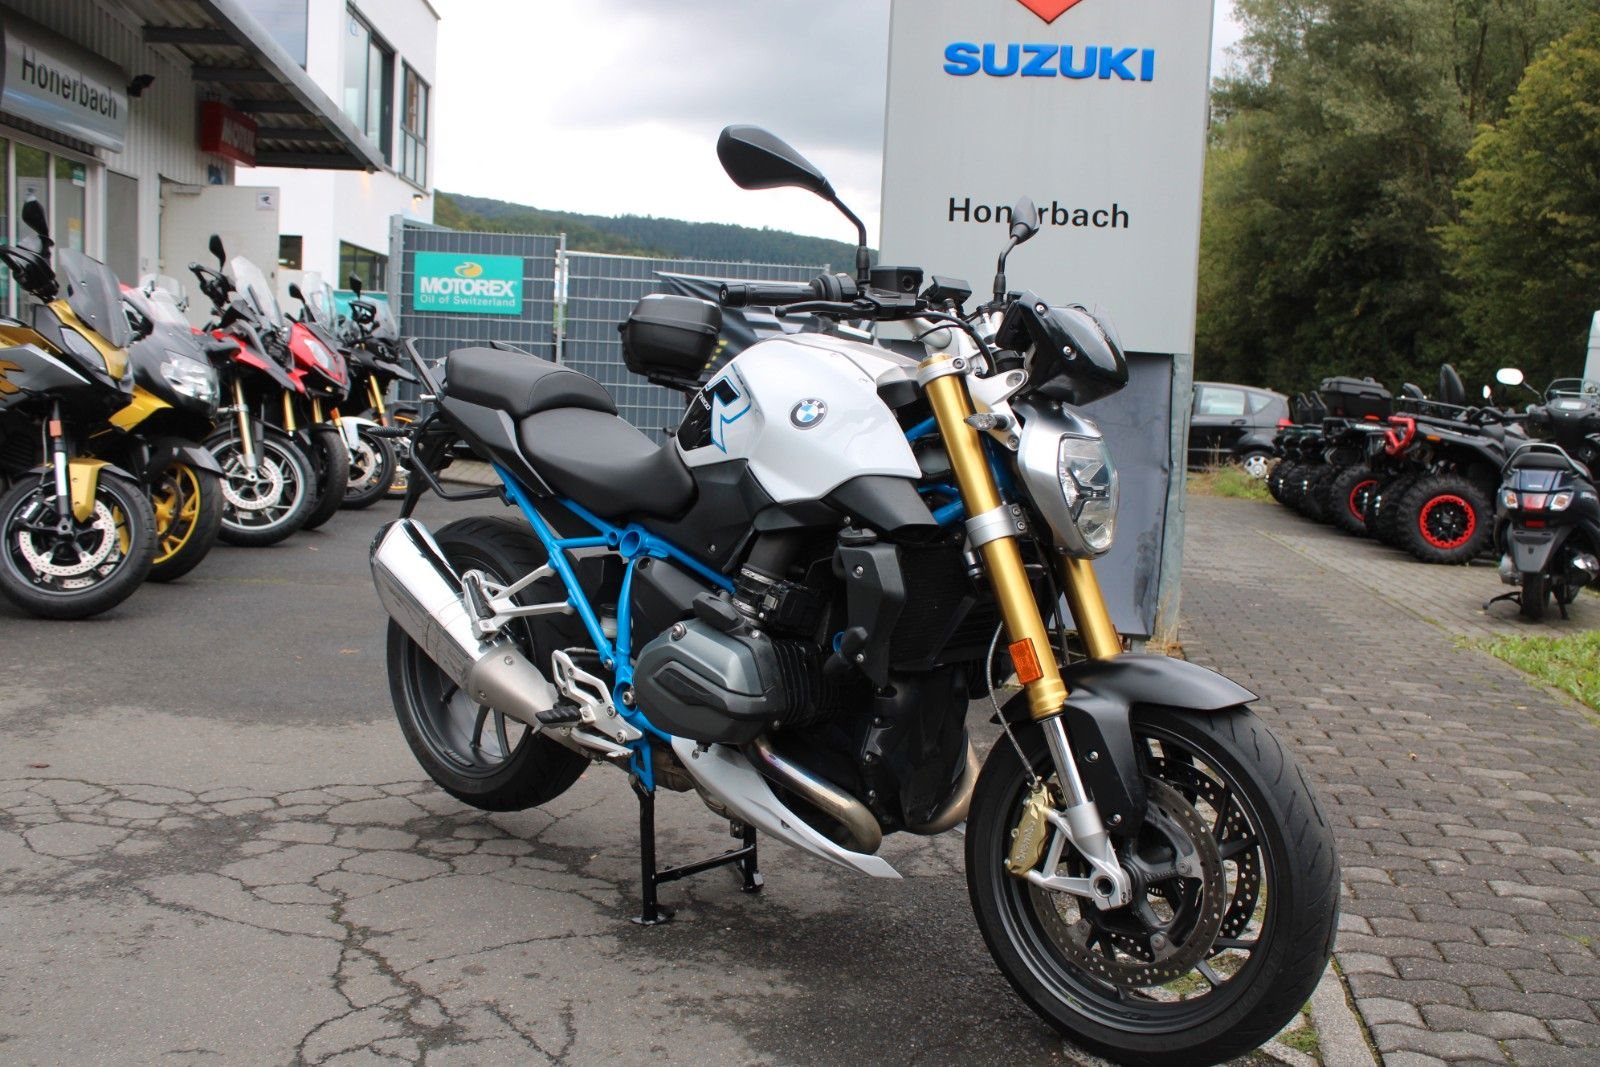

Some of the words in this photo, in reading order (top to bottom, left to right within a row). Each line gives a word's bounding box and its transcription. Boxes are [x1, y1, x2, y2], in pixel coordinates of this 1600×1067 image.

[943, 42, 1155, 82] SUZUKI
[22, 45, 118, 120] Honerbach
[948, 197, 1129, 229] Honrbach
[420, 276, 514, 297] MOTOREX
[420, 294, 435, 304] Oil
[438, 296, 450, 305] of
[453, 295, 516, 308] Switzerland
